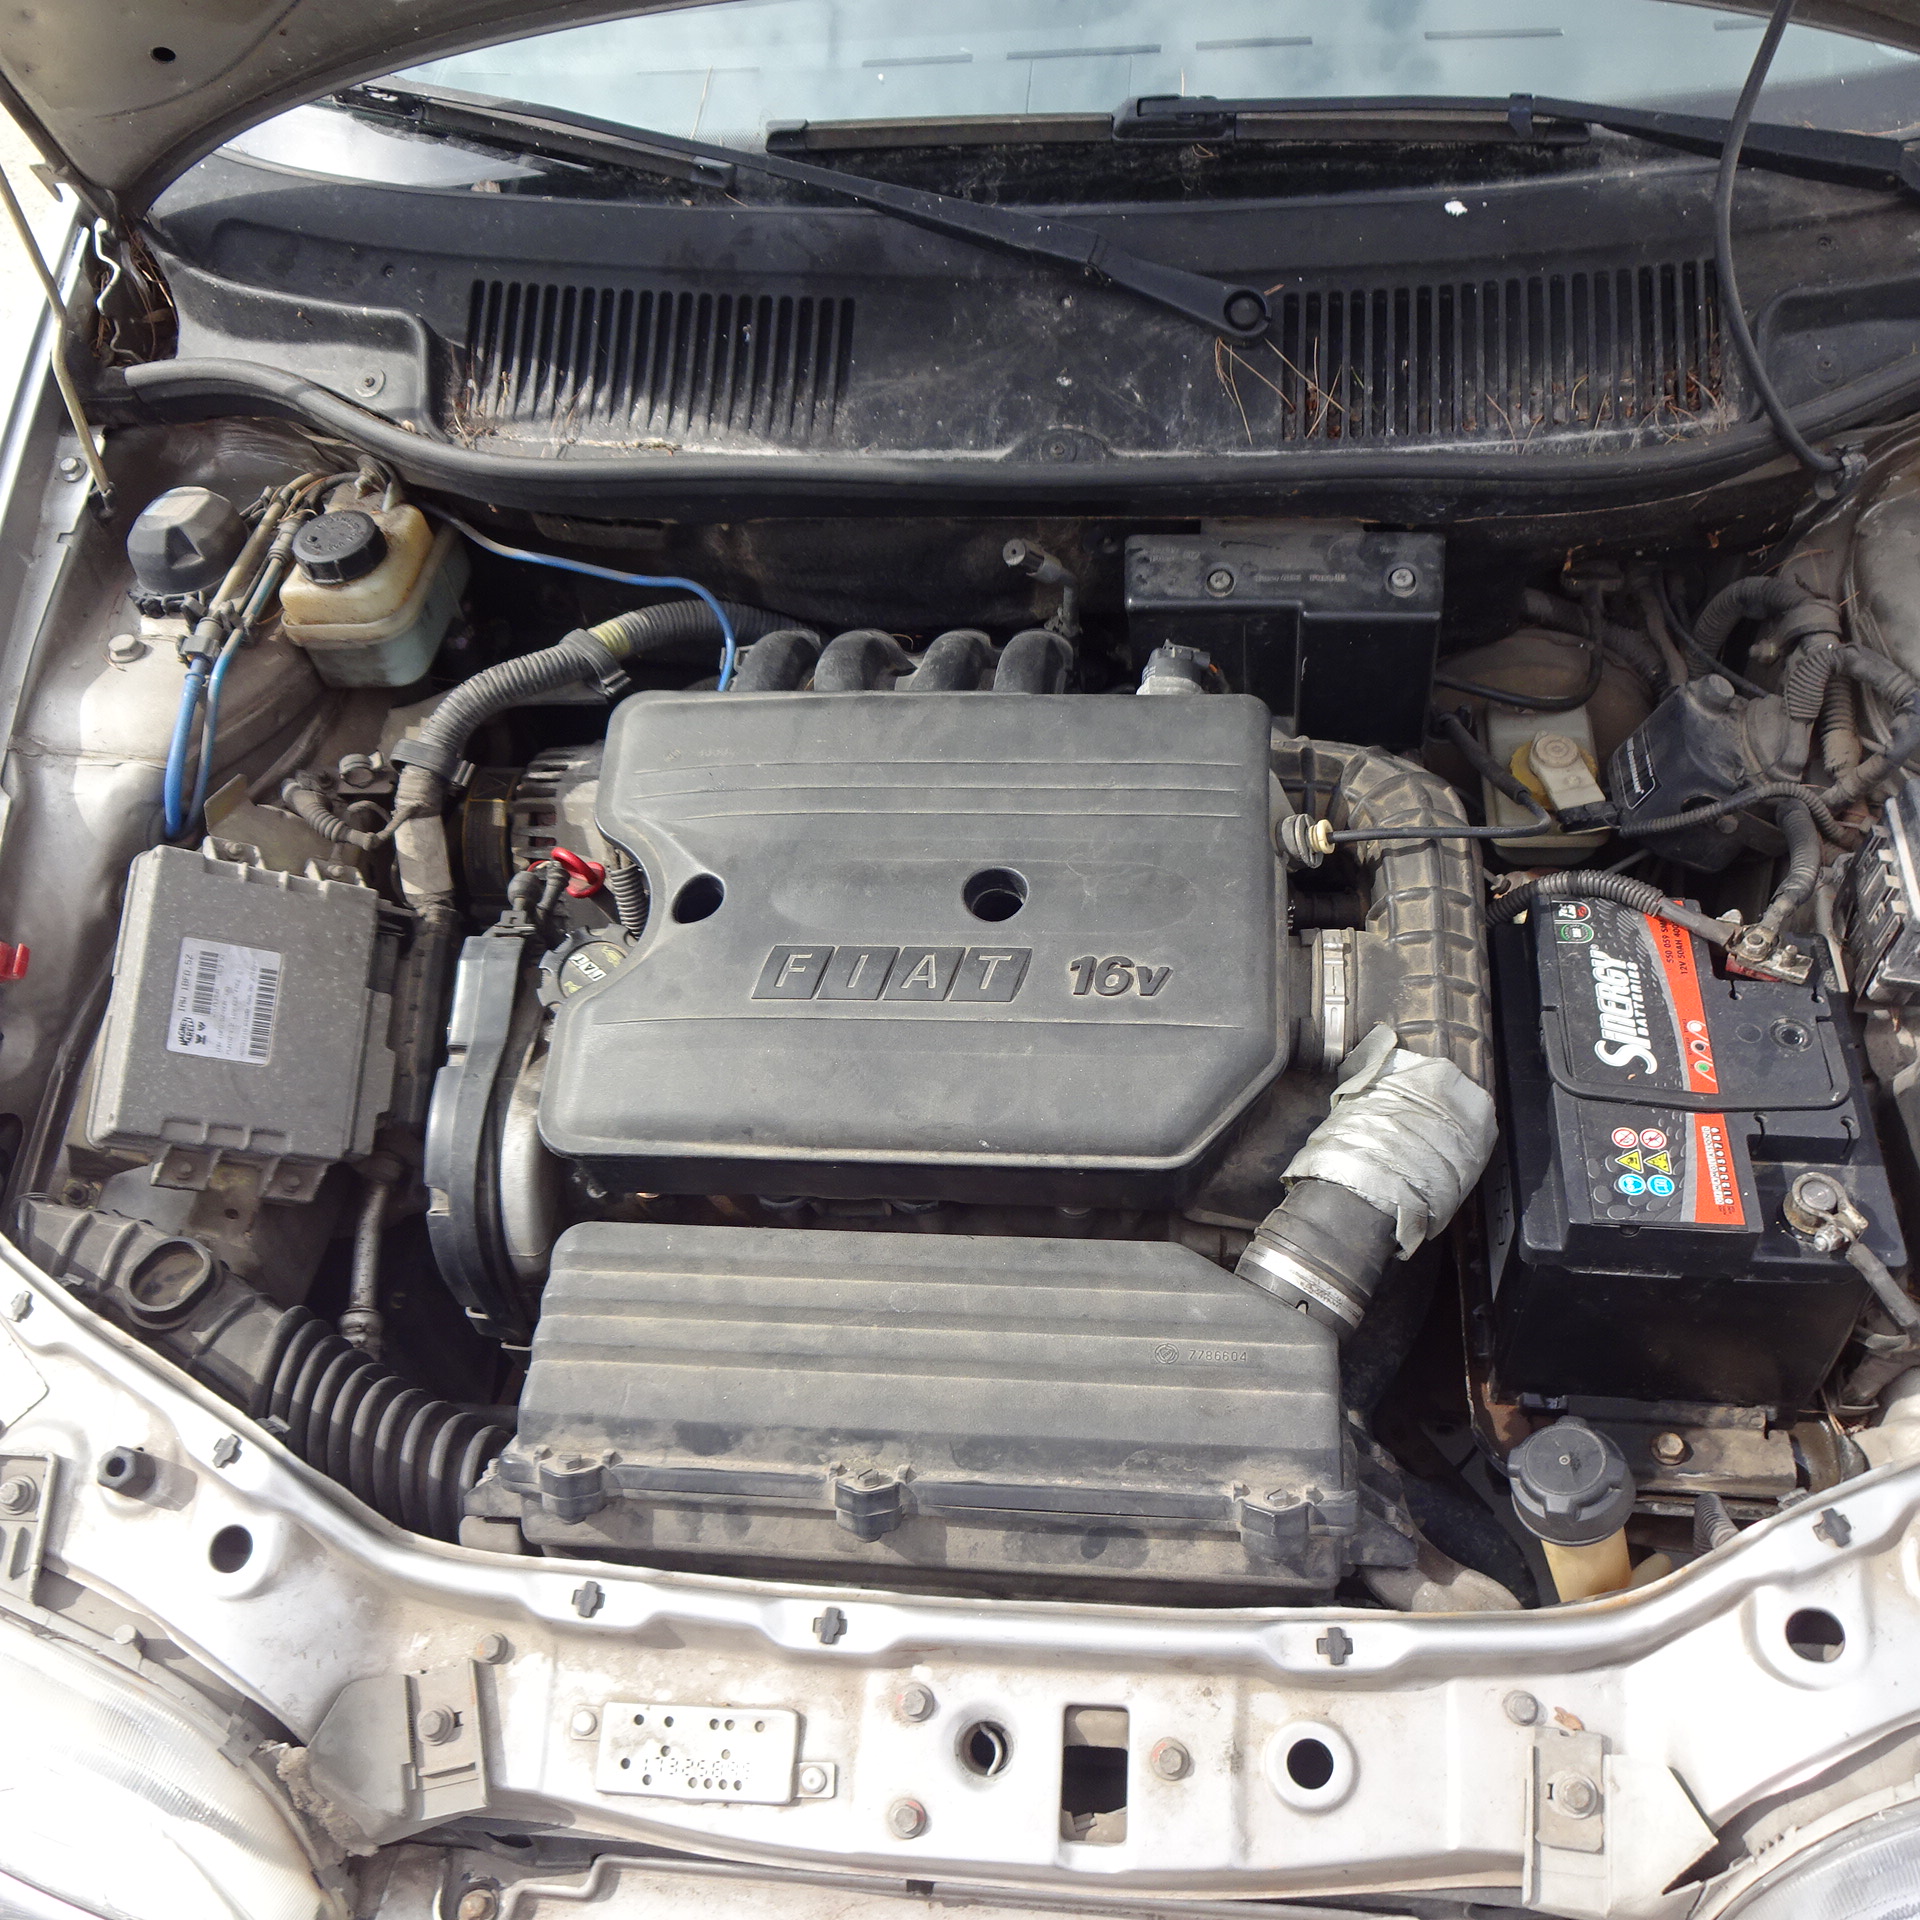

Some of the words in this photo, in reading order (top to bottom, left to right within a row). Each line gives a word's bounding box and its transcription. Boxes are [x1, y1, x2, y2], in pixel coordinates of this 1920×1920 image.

[1661, 934, 1672, 948] 059
[1675, 939, 1686, 958] 50AH
[1664, 950, 1675, 963] 550
[571, 954, 606, 981] IAT
[771, 950, 1015, 992] FIAT
[1069, 954, 1174, 997] 16v
[1678, 961, 1689, 974] 12V
[1626, 961, 1650, 1037] BATTERIES
[1589, 949, 1658, 1075] SINERGY
[1188, 1349, 1248, 1362] 7786604
